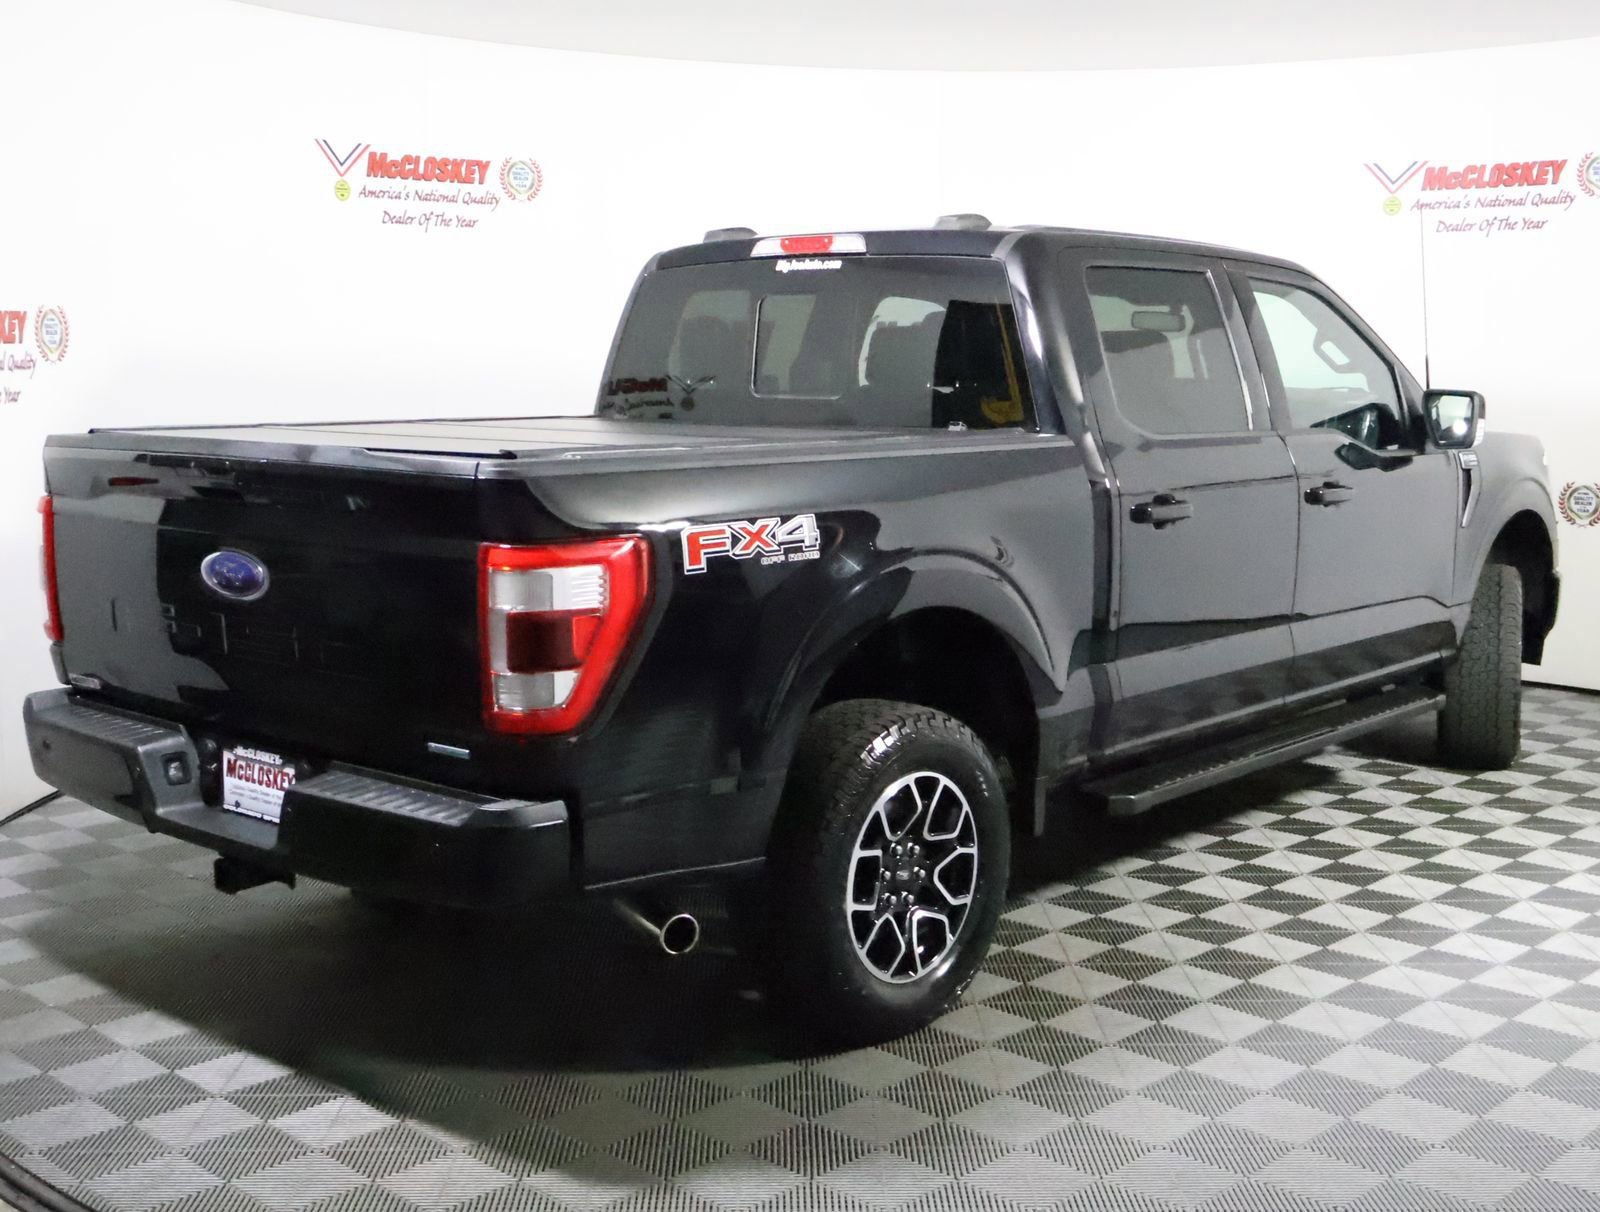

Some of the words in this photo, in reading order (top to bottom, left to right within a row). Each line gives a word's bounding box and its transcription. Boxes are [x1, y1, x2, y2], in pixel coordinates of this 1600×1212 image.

[366, 151, 491, 185] McCLOSKEY
[1421, 159, 1568, 191] McCLOSKEY
[358, 185, 410, 201] America's
[413, 189, 459, 204] National
[462, 190, 500, 212] Quality
[1410, 194, 1471, 212] America's
[1474, 191, 1528, 209] National
[1531, 189, 1576, 211] Quality
[381, 210, 416, 225] Dealer
[418, 211, 433, 233] Of
[434, 213, 452, 228] The
[455, 215, 479, 229] Year
[1436, 218, 1476, 233] Dealer
[1478, 217, 1497, 238] Of
[1498, 216, 1518, 231] The
[1521, 217, 1549, 230] Year
[680, 513, 821, 575] FX4
